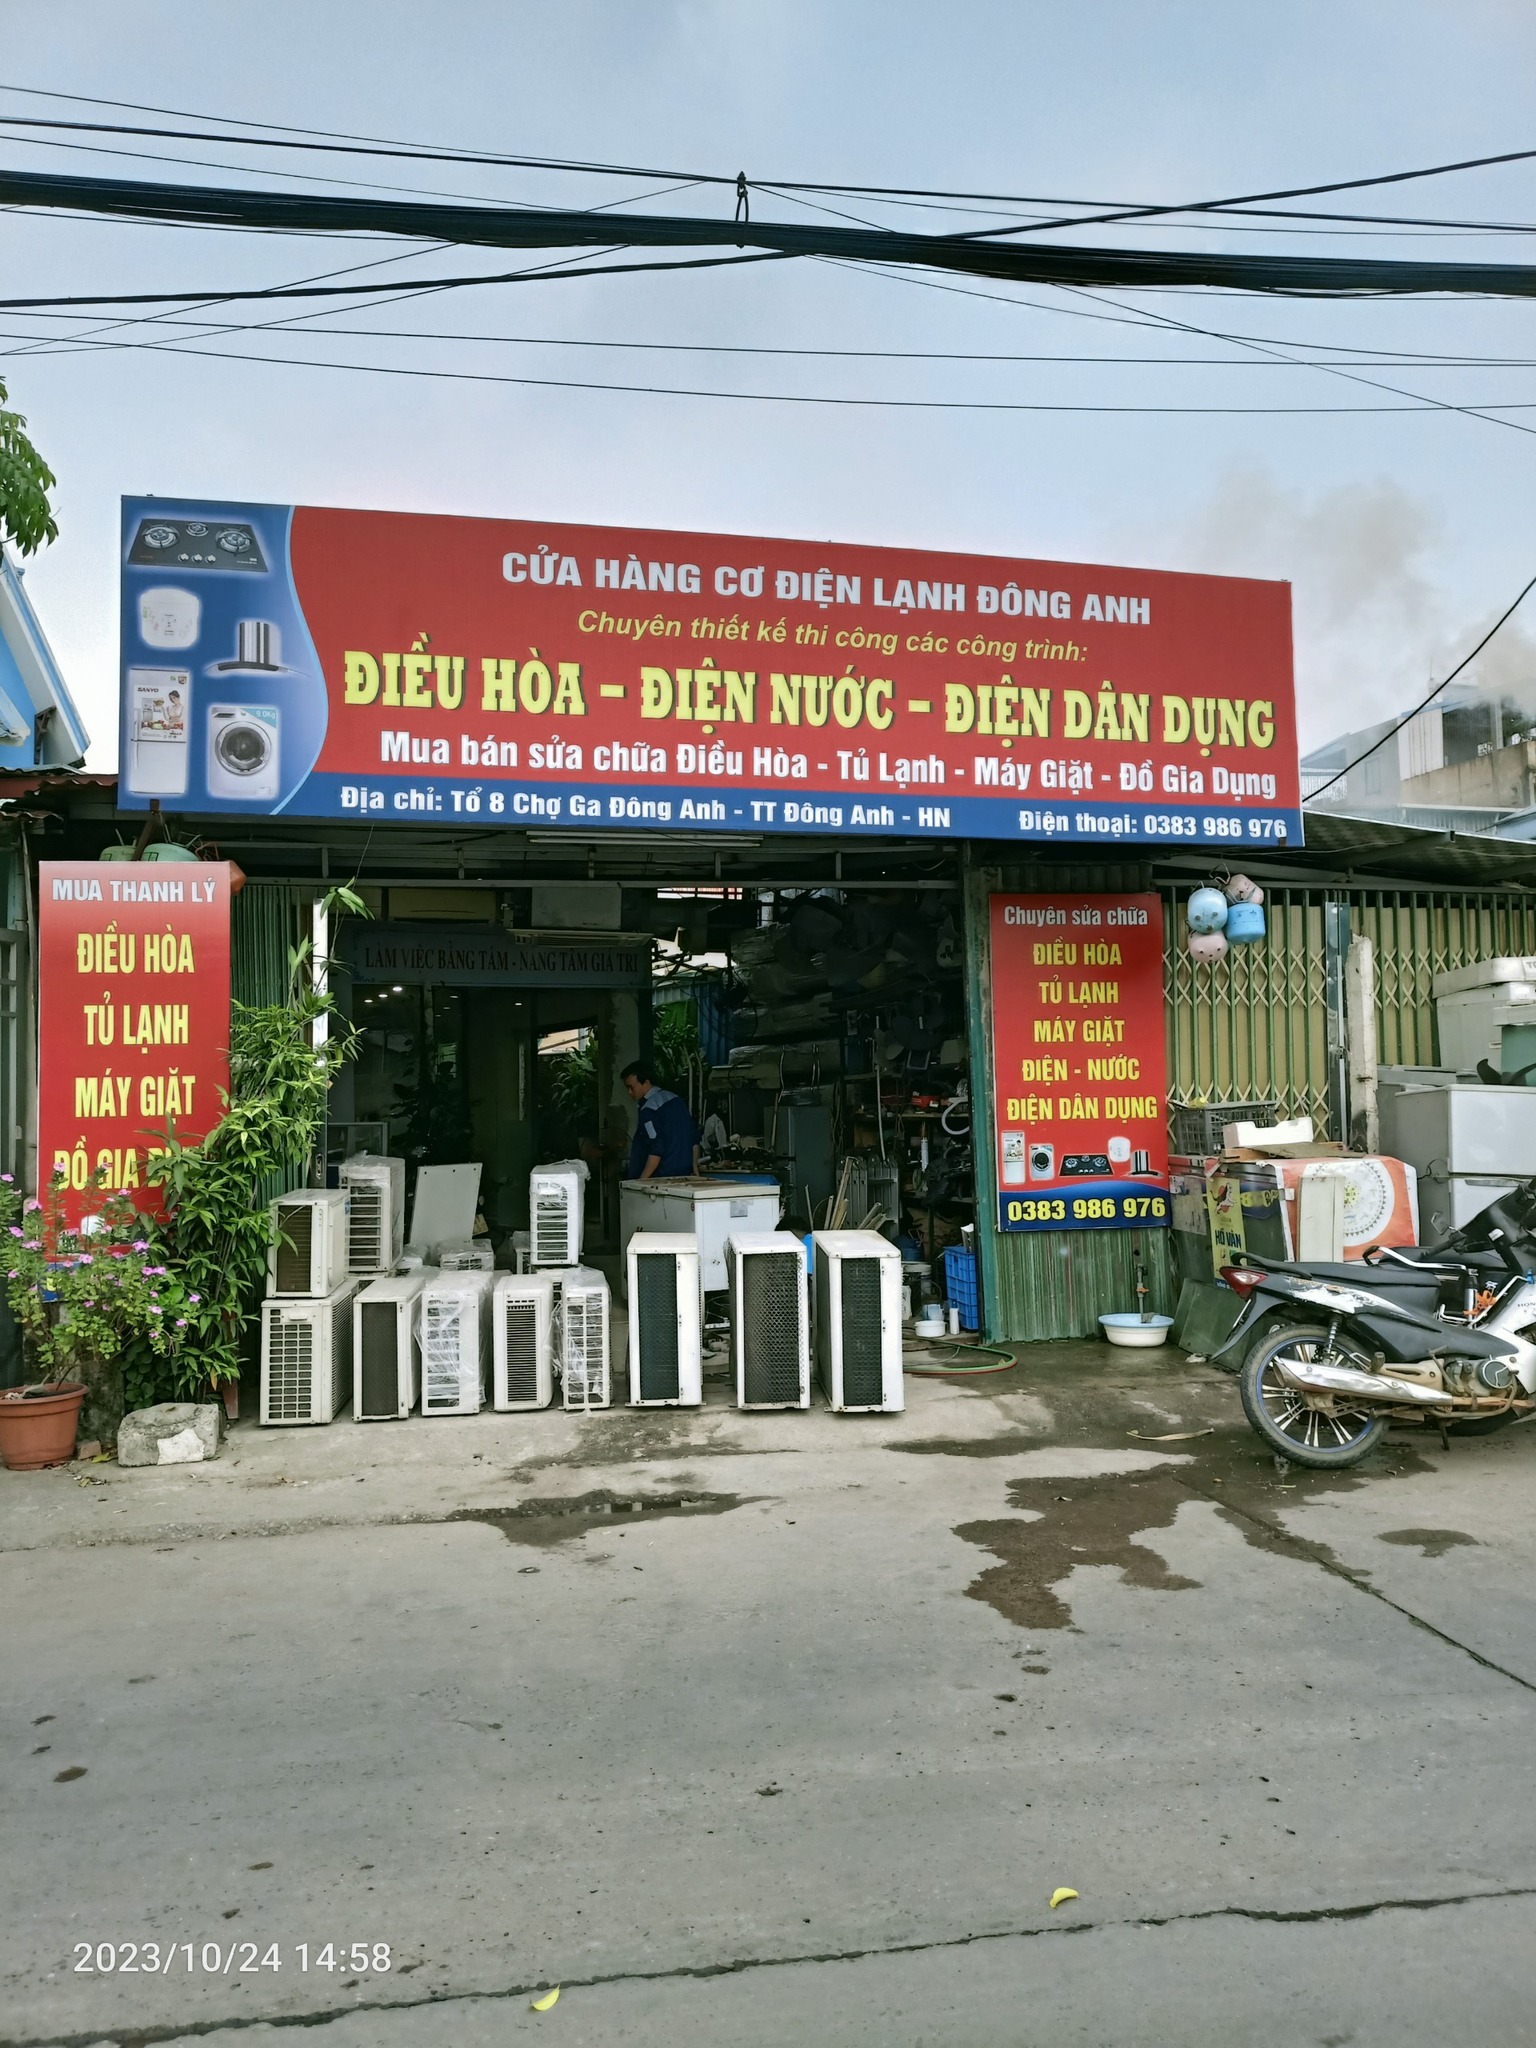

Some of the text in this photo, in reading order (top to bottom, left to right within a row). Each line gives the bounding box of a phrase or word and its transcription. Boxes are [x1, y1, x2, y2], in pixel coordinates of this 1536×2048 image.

[503, 545, 1150, 624] CỬA HÀNG CƠ ĐIỆN LẠNH ĐÔNG ANH
[579, 611, 1087, 662] Chuyên thiết kế thi công các công trình:
[345, 633, 1273, 756] ĐIỀU HÒA - ĐIỆN NƯỚC - ĐIỆN DÂN DỤNG
[382, 731, 449, 763] Mua
[462, 735, 517, 766] bán
[529, 735, 582, 769] sửa
[594, 742, 666, 772] chữa
[676, 740, 742, 775] Điều
[754, 747, 807, 778] Hòa
[837, 748, 869, 780] Tủ
[880, 753, 944, 788] Lạnh
[975, 757, 1031, 790] Máy
[1041, 760, 1093, 794] Giặt
[1120, 760, 1153, 791] Đồ
[1163, 765, 1203, 793] Gia
[1213, 767, 1275, 801] Dụng
[341, 787, 384, 813] Địa
[394, 787, 441, 810] chỉ:
[451, 787, 482, 812] Tổ
[490, 793, 504, 812] 8
[514, 793, 561, 819] Chợ
[570, 795, 600, 816] Ga
[609, 797, 671, 820] Đông
[680, 799, 725, 820] Anh
[751, 801, 776, 821] TT
[784, 803, 842, 826] Đông
[851, 805, 894, 825] Anh
[919, 807, 950, 827] HN
[1019, 811, 1286, 837] Điện thoại: 0383 986 976
[53, 878, 215, 902] MUA THANH LÝ
[1005, 905, 1147, 927] Chuyên sửa chữa
[77, 921, 194, 973] ĐIỀU HÒA
[402, 944, 434, 973] VIỆC
[1033, 939, 1122, 965] ĐIỀU HÒA
[1039, 975, 1118, 1008] TỦ LẠNH
[84, 991, 188, 1053] TỦ LẠNH
[1034, 1016, 1124, 1046] MÁY GIẶT
[1022, 1055, 1067, 1085] ĐIỆN
[1088, 1054, 1139, 1080] NƯỚC
[76, 1068, 195, 1124] MÁY GIẶT
[1007, 1093, 1157, 1125] ĐIỆN DÂN DỤNG
[97, 1149, 139, 1189] GIA
[1008, 1198, 1165, 1221] 0383 986 976
